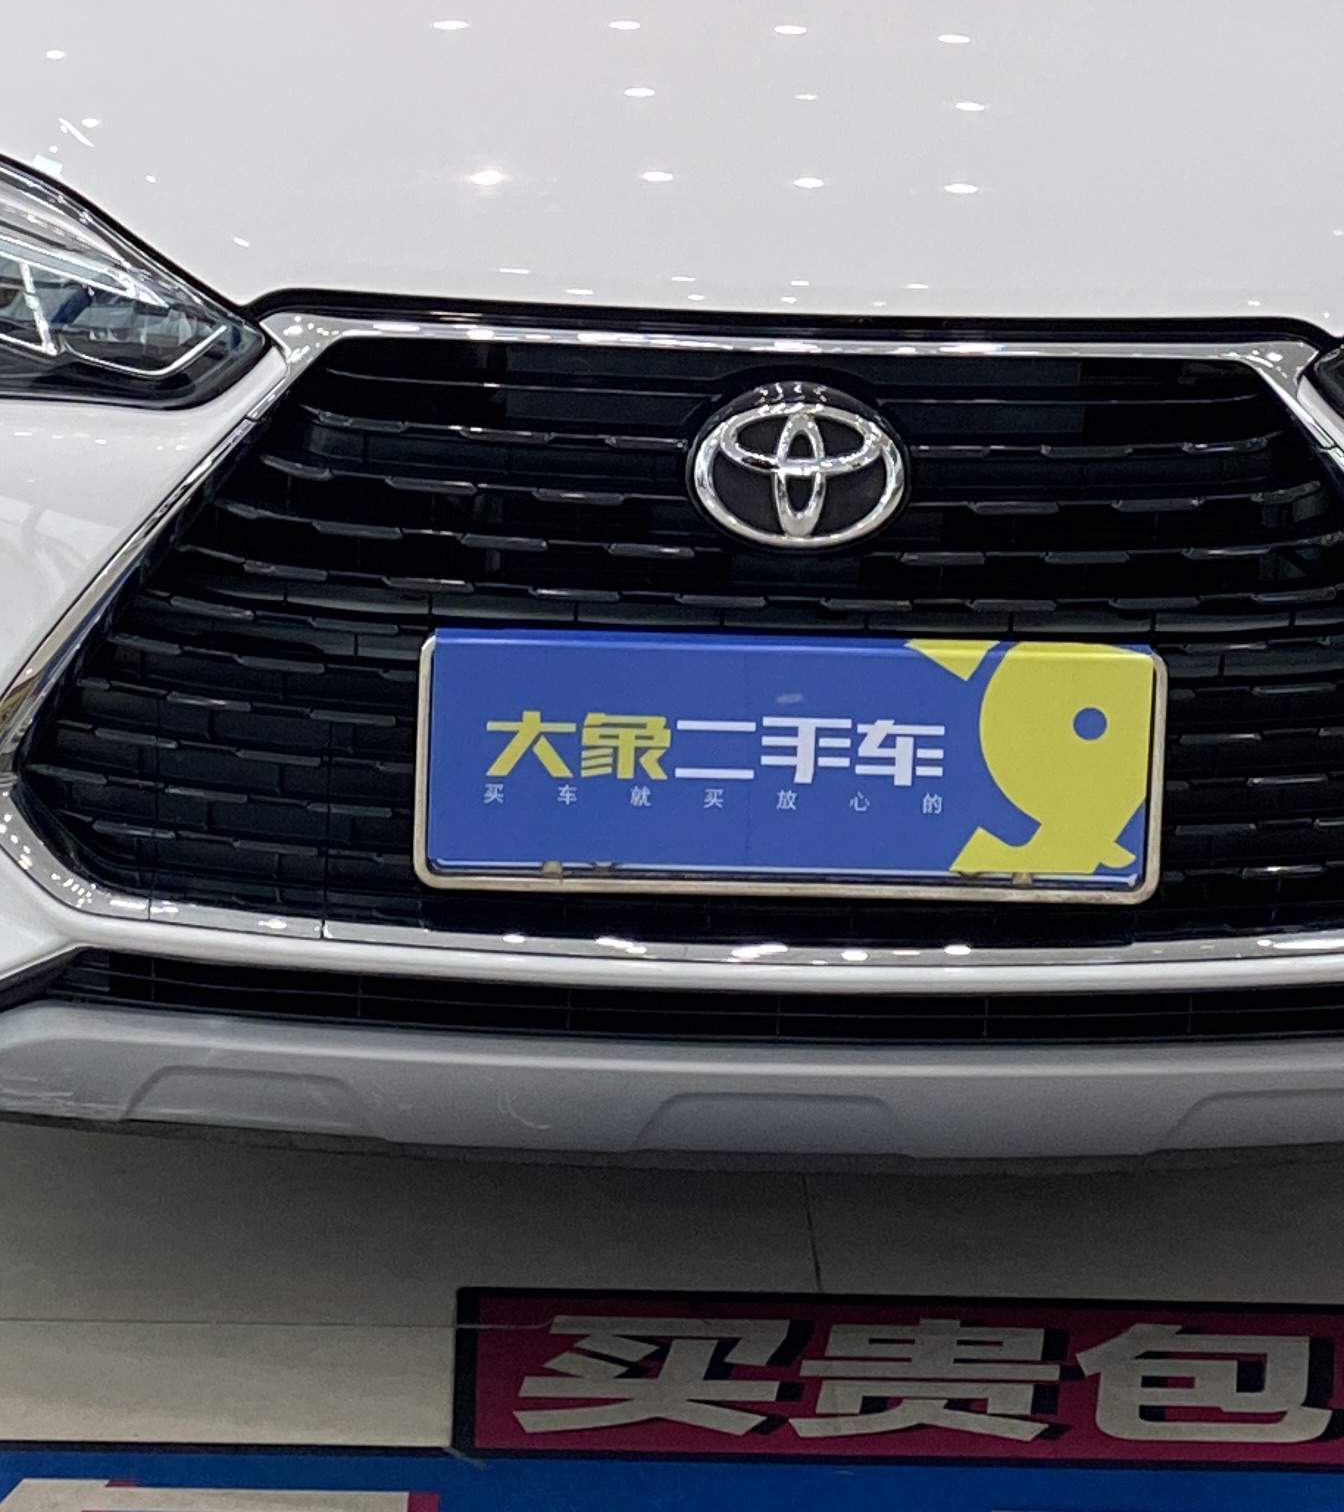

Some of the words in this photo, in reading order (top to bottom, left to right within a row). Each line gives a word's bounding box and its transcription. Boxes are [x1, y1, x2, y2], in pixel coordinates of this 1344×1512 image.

[485, 709, 946, 787] 大象二手车
[484, 781, 944, 816] 买车就买放心的
